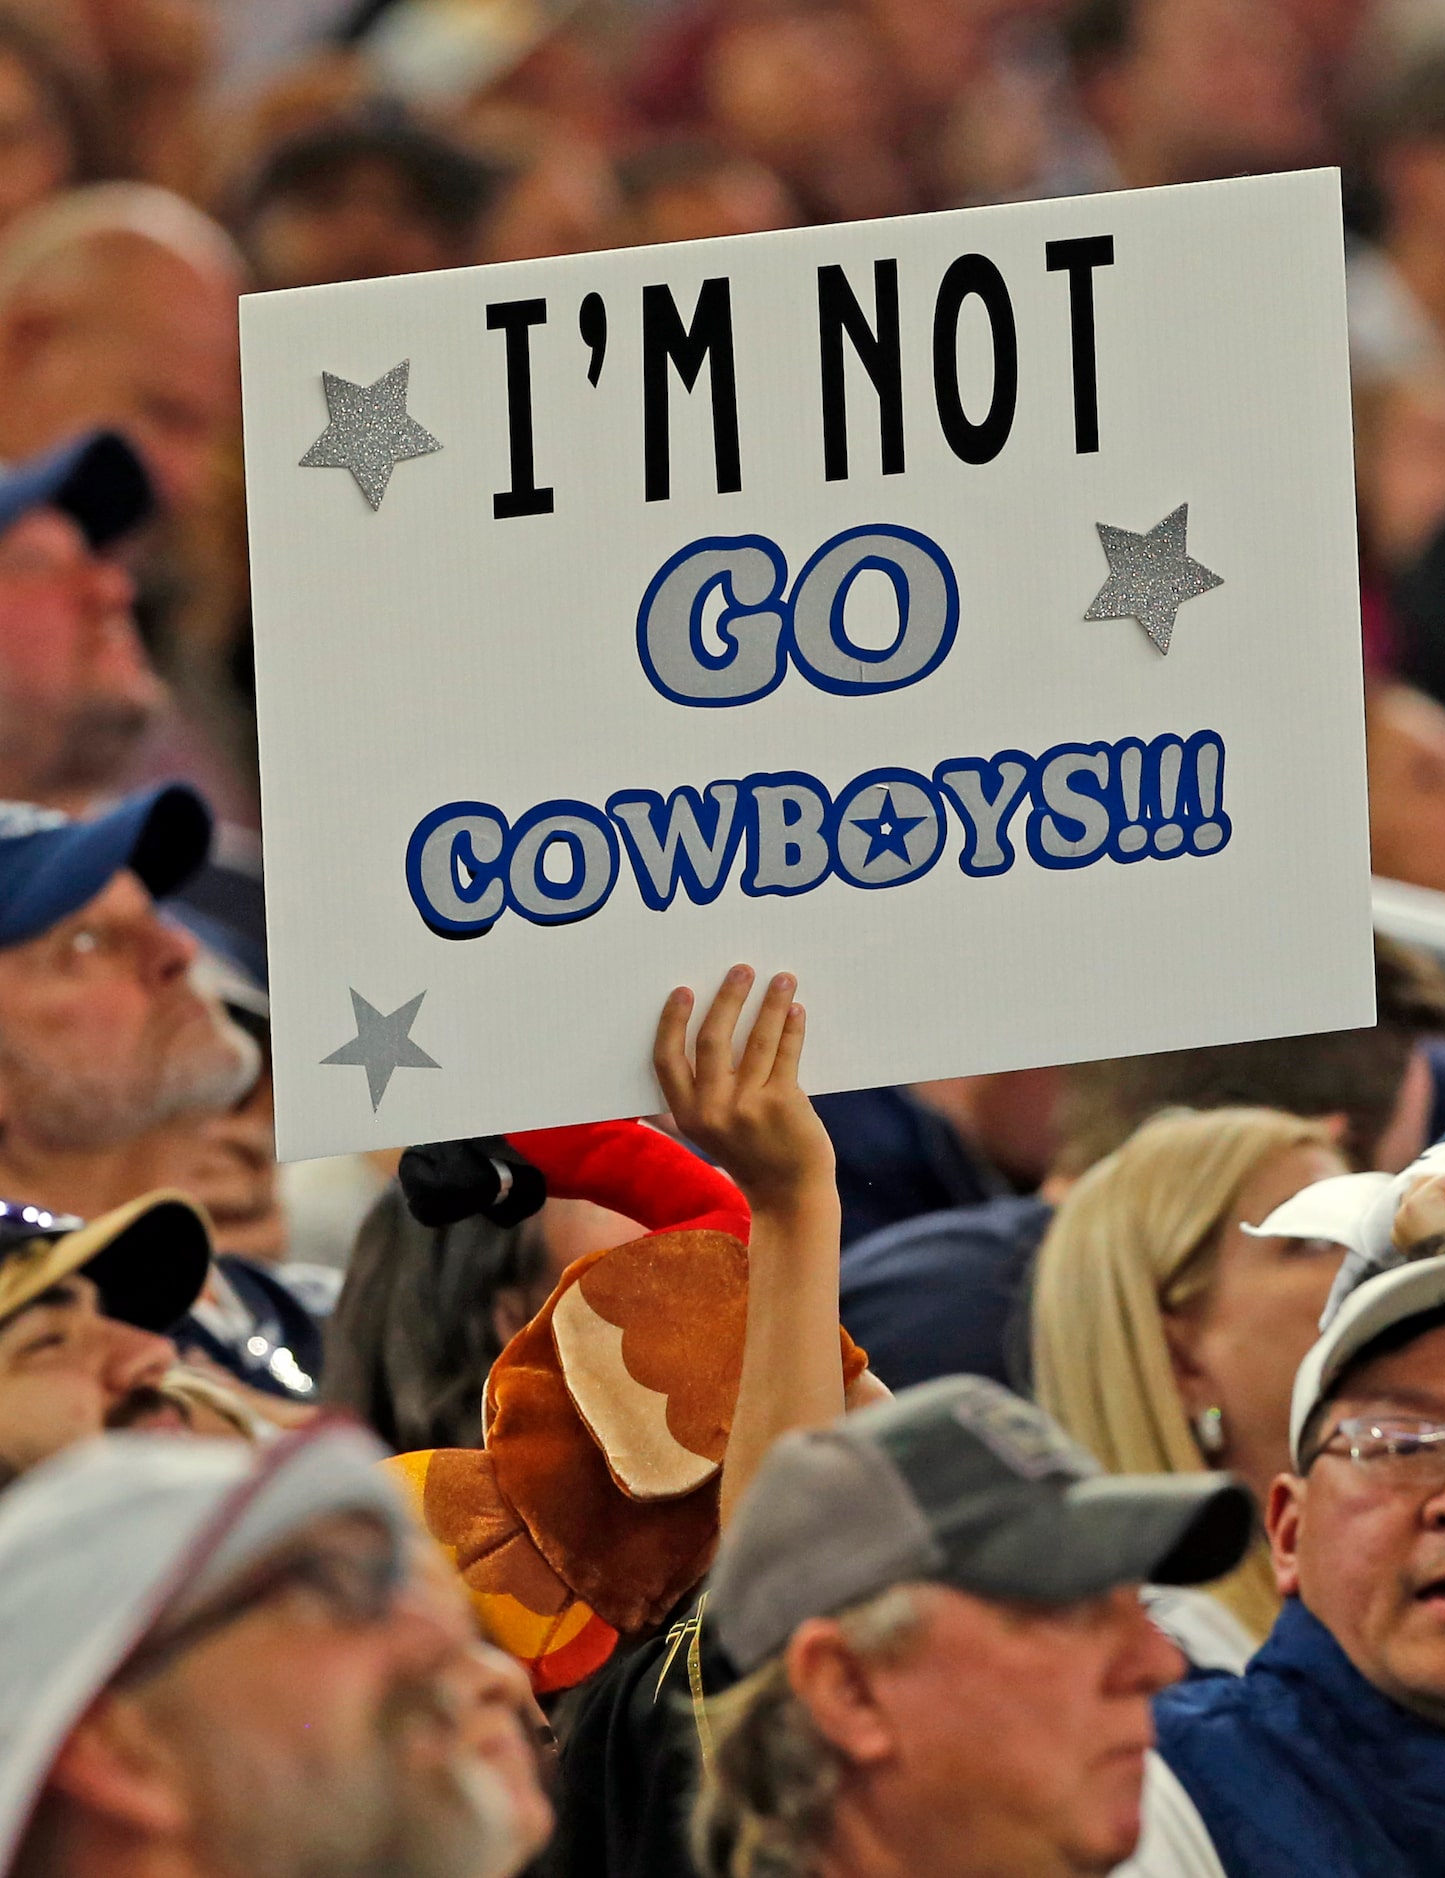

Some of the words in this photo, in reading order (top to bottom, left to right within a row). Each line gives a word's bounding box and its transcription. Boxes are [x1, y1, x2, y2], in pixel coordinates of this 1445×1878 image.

[486, 277, 742, 520] I'M
[817, 234, 1115, 482] NOT
[637, 524, 960, 708] GO
[406, 730, 1232, 941] COWBOYS!!!
